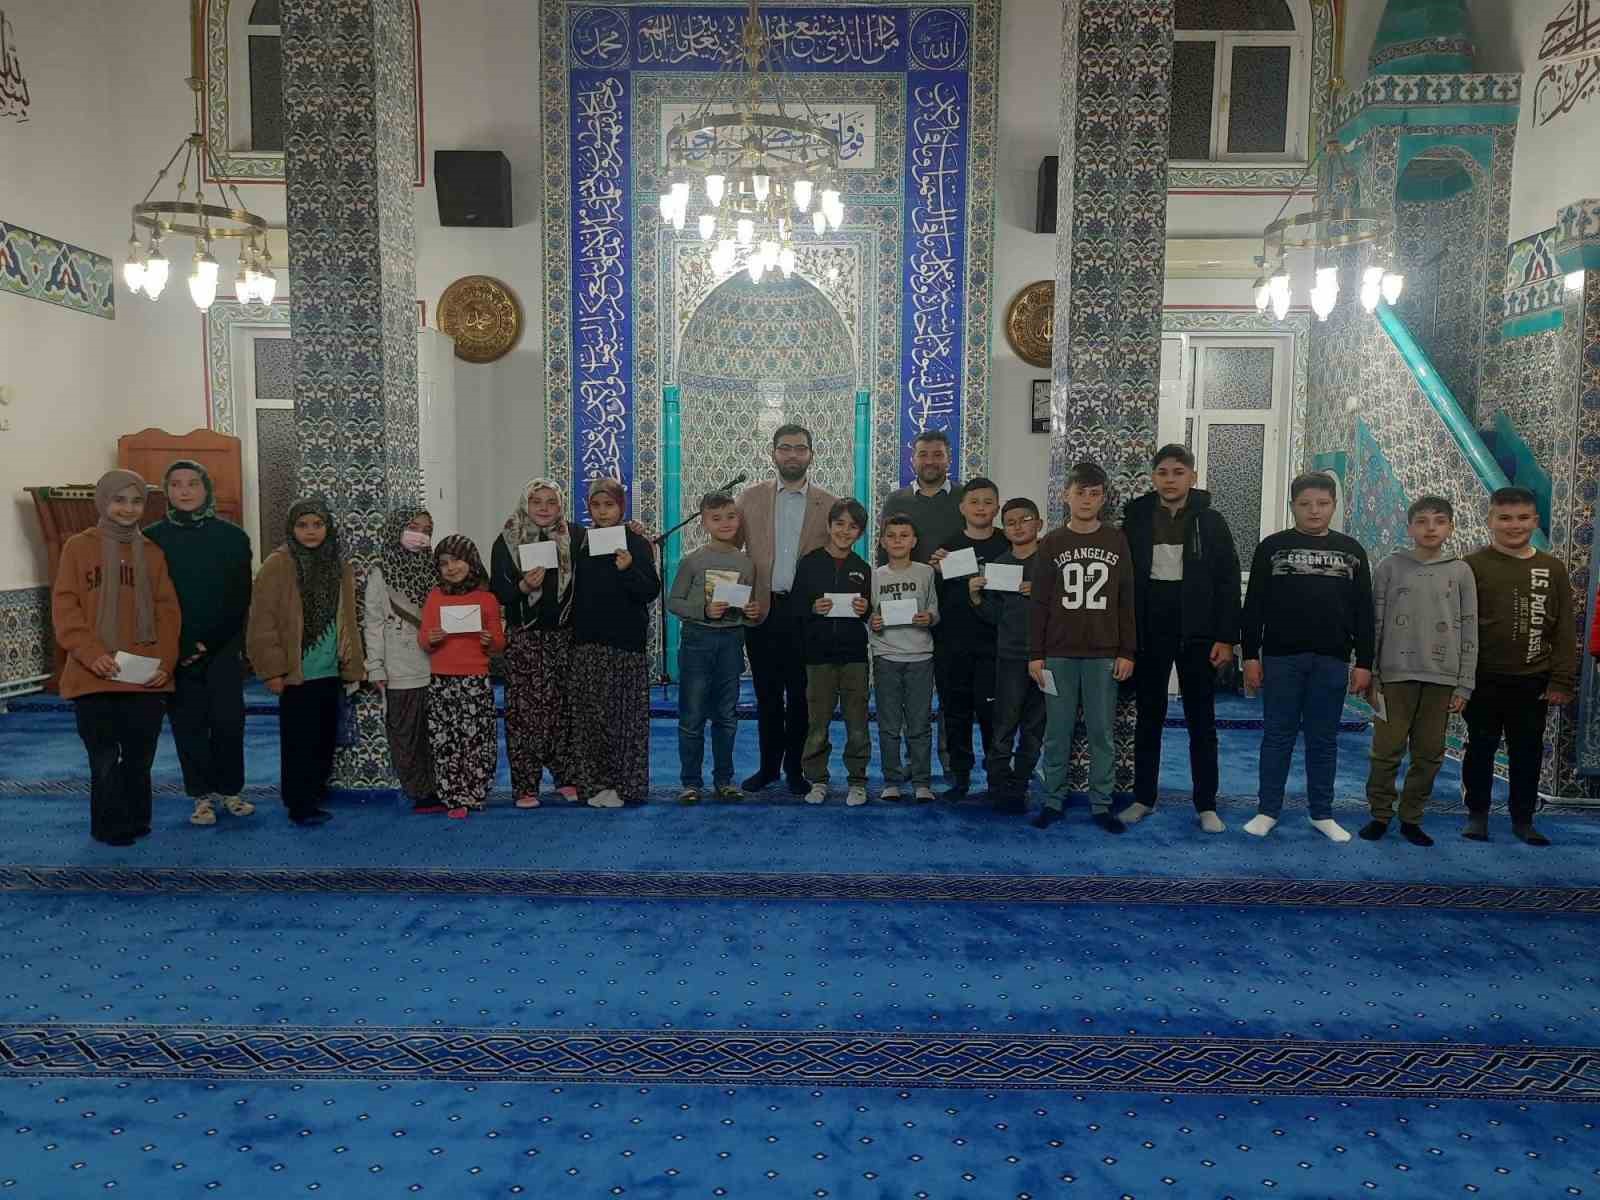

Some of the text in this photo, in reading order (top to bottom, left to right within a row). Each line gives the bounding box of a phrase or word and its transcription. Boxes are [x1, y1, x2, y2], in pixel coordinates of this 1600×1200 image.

[581, 28, 623, 59] محمد
[1053, 547, 1120, 568] LOS ANGELES
[880, 582, 917, 593] JUST DO
[1061, 562, 1109, 610] 92
[1530, 568, 1550, 590] U.S.
[893, 592, 902, 600] IT
[1530, 593, 1547, 625] POLO
